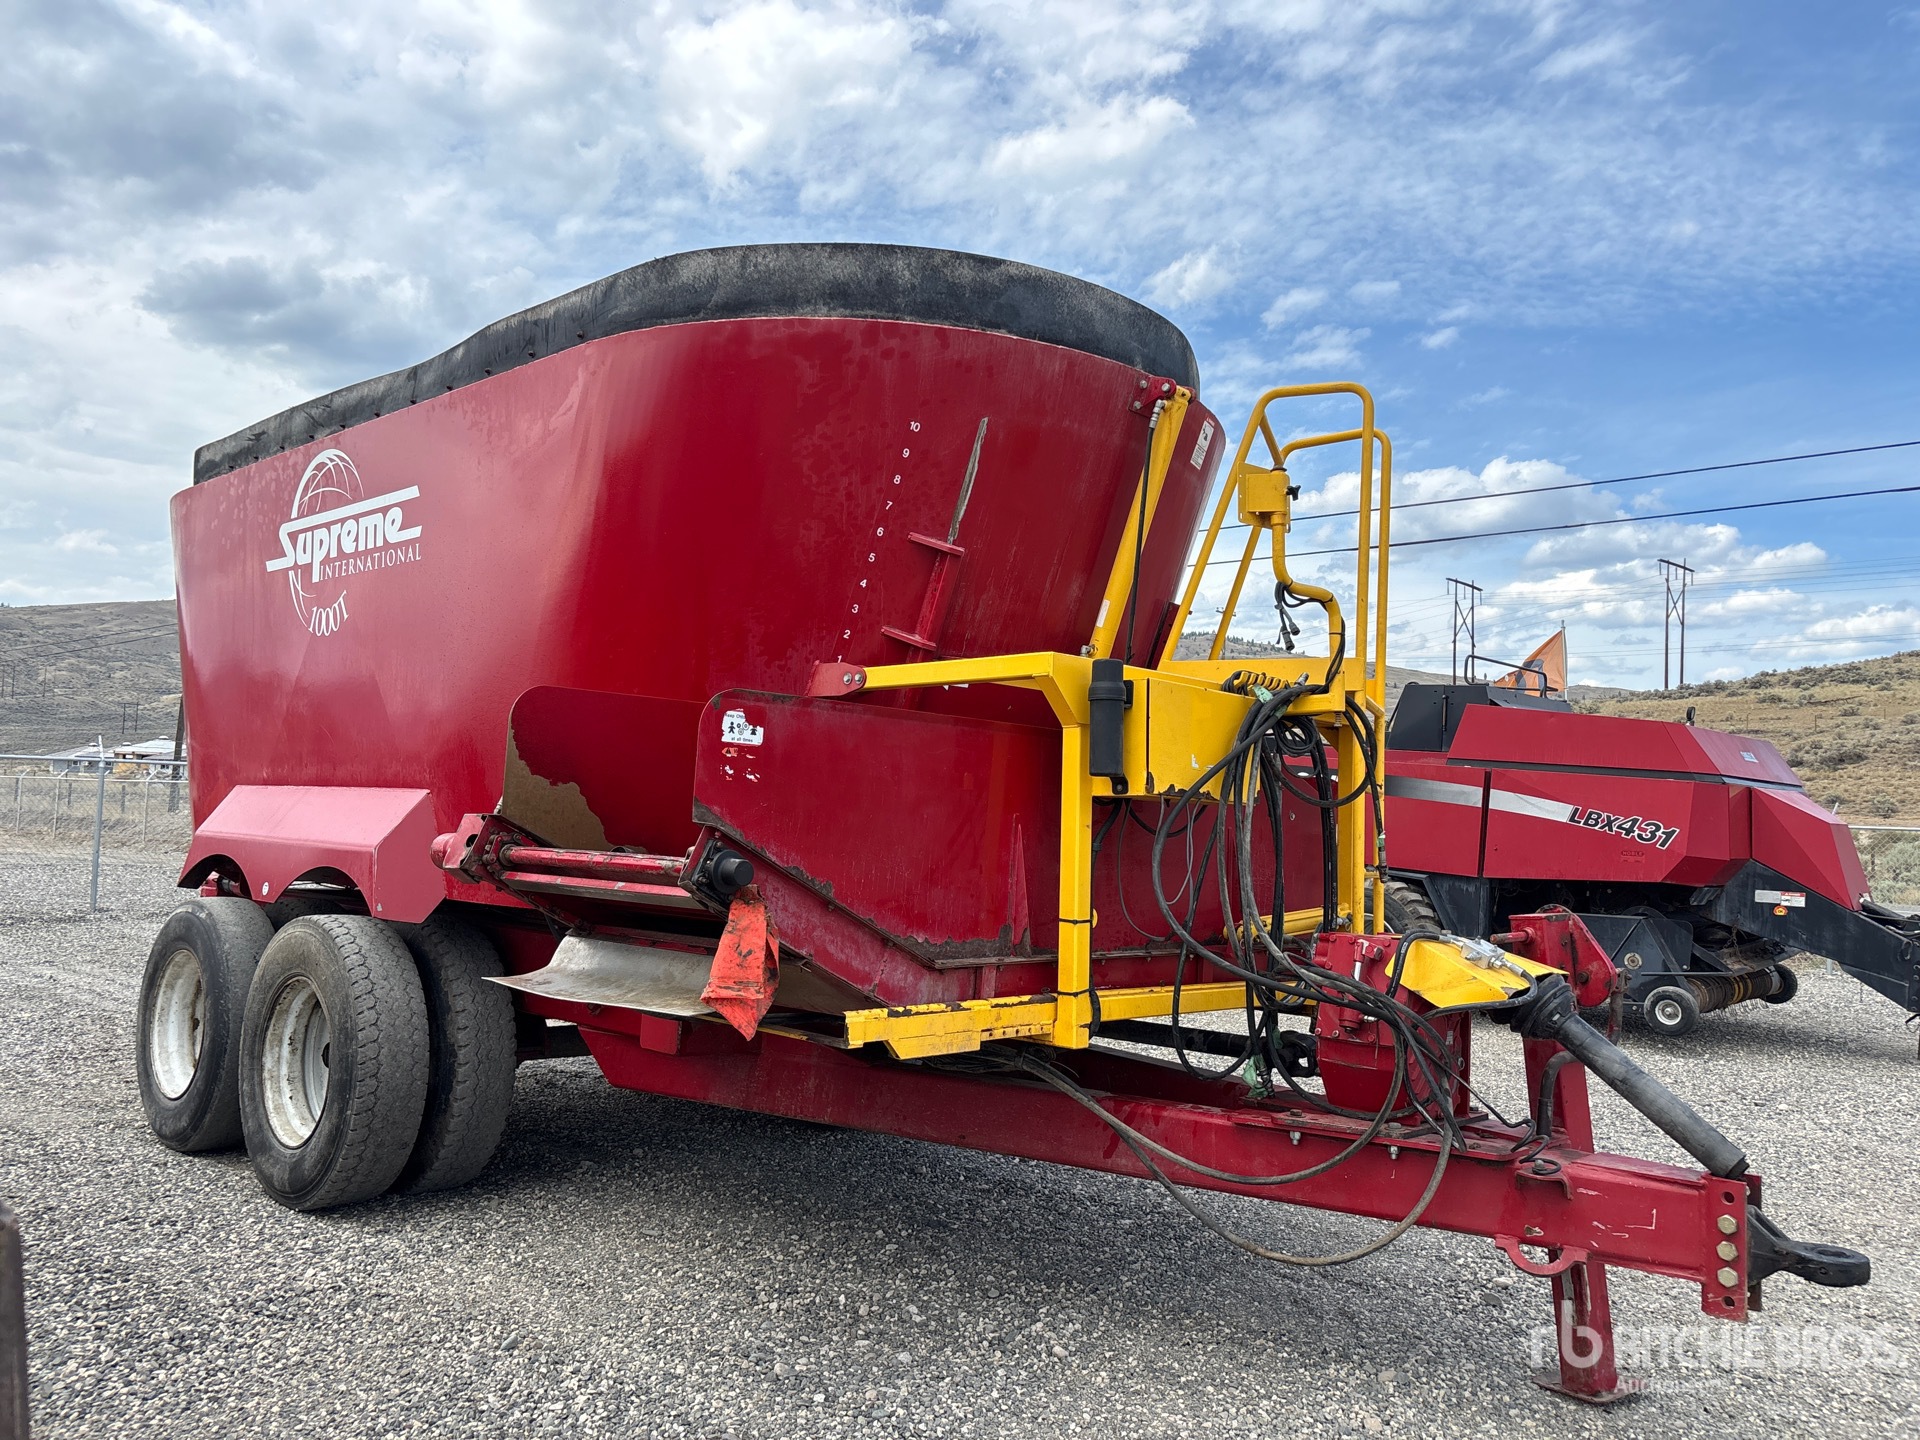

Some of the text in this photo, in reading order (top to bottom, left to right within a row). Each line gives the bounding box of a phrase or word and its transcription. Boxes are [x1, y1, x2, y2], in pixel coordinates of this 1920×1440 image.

[909, 421, 921, 432] 10
[902, 448, 910, 458] 9
[893, 475, 901, 485] 8
[885, 501, 892, 510] 7
[265, 485, 423, 584] Supreme
[876, 527, 884, 537] 6
[319, 543, 422, 581] INTERNATIONAL
[868, 553, 876, 562] 5
[860, 579, 867, 588] 4
[308, 589, 350, 637] 1000T
[851, 604, 859, 613] 3
[843, 630, 851, 639] 2
[837, 655, 842, 663] 1
[1567, 806, 1680, 850] LBX431
